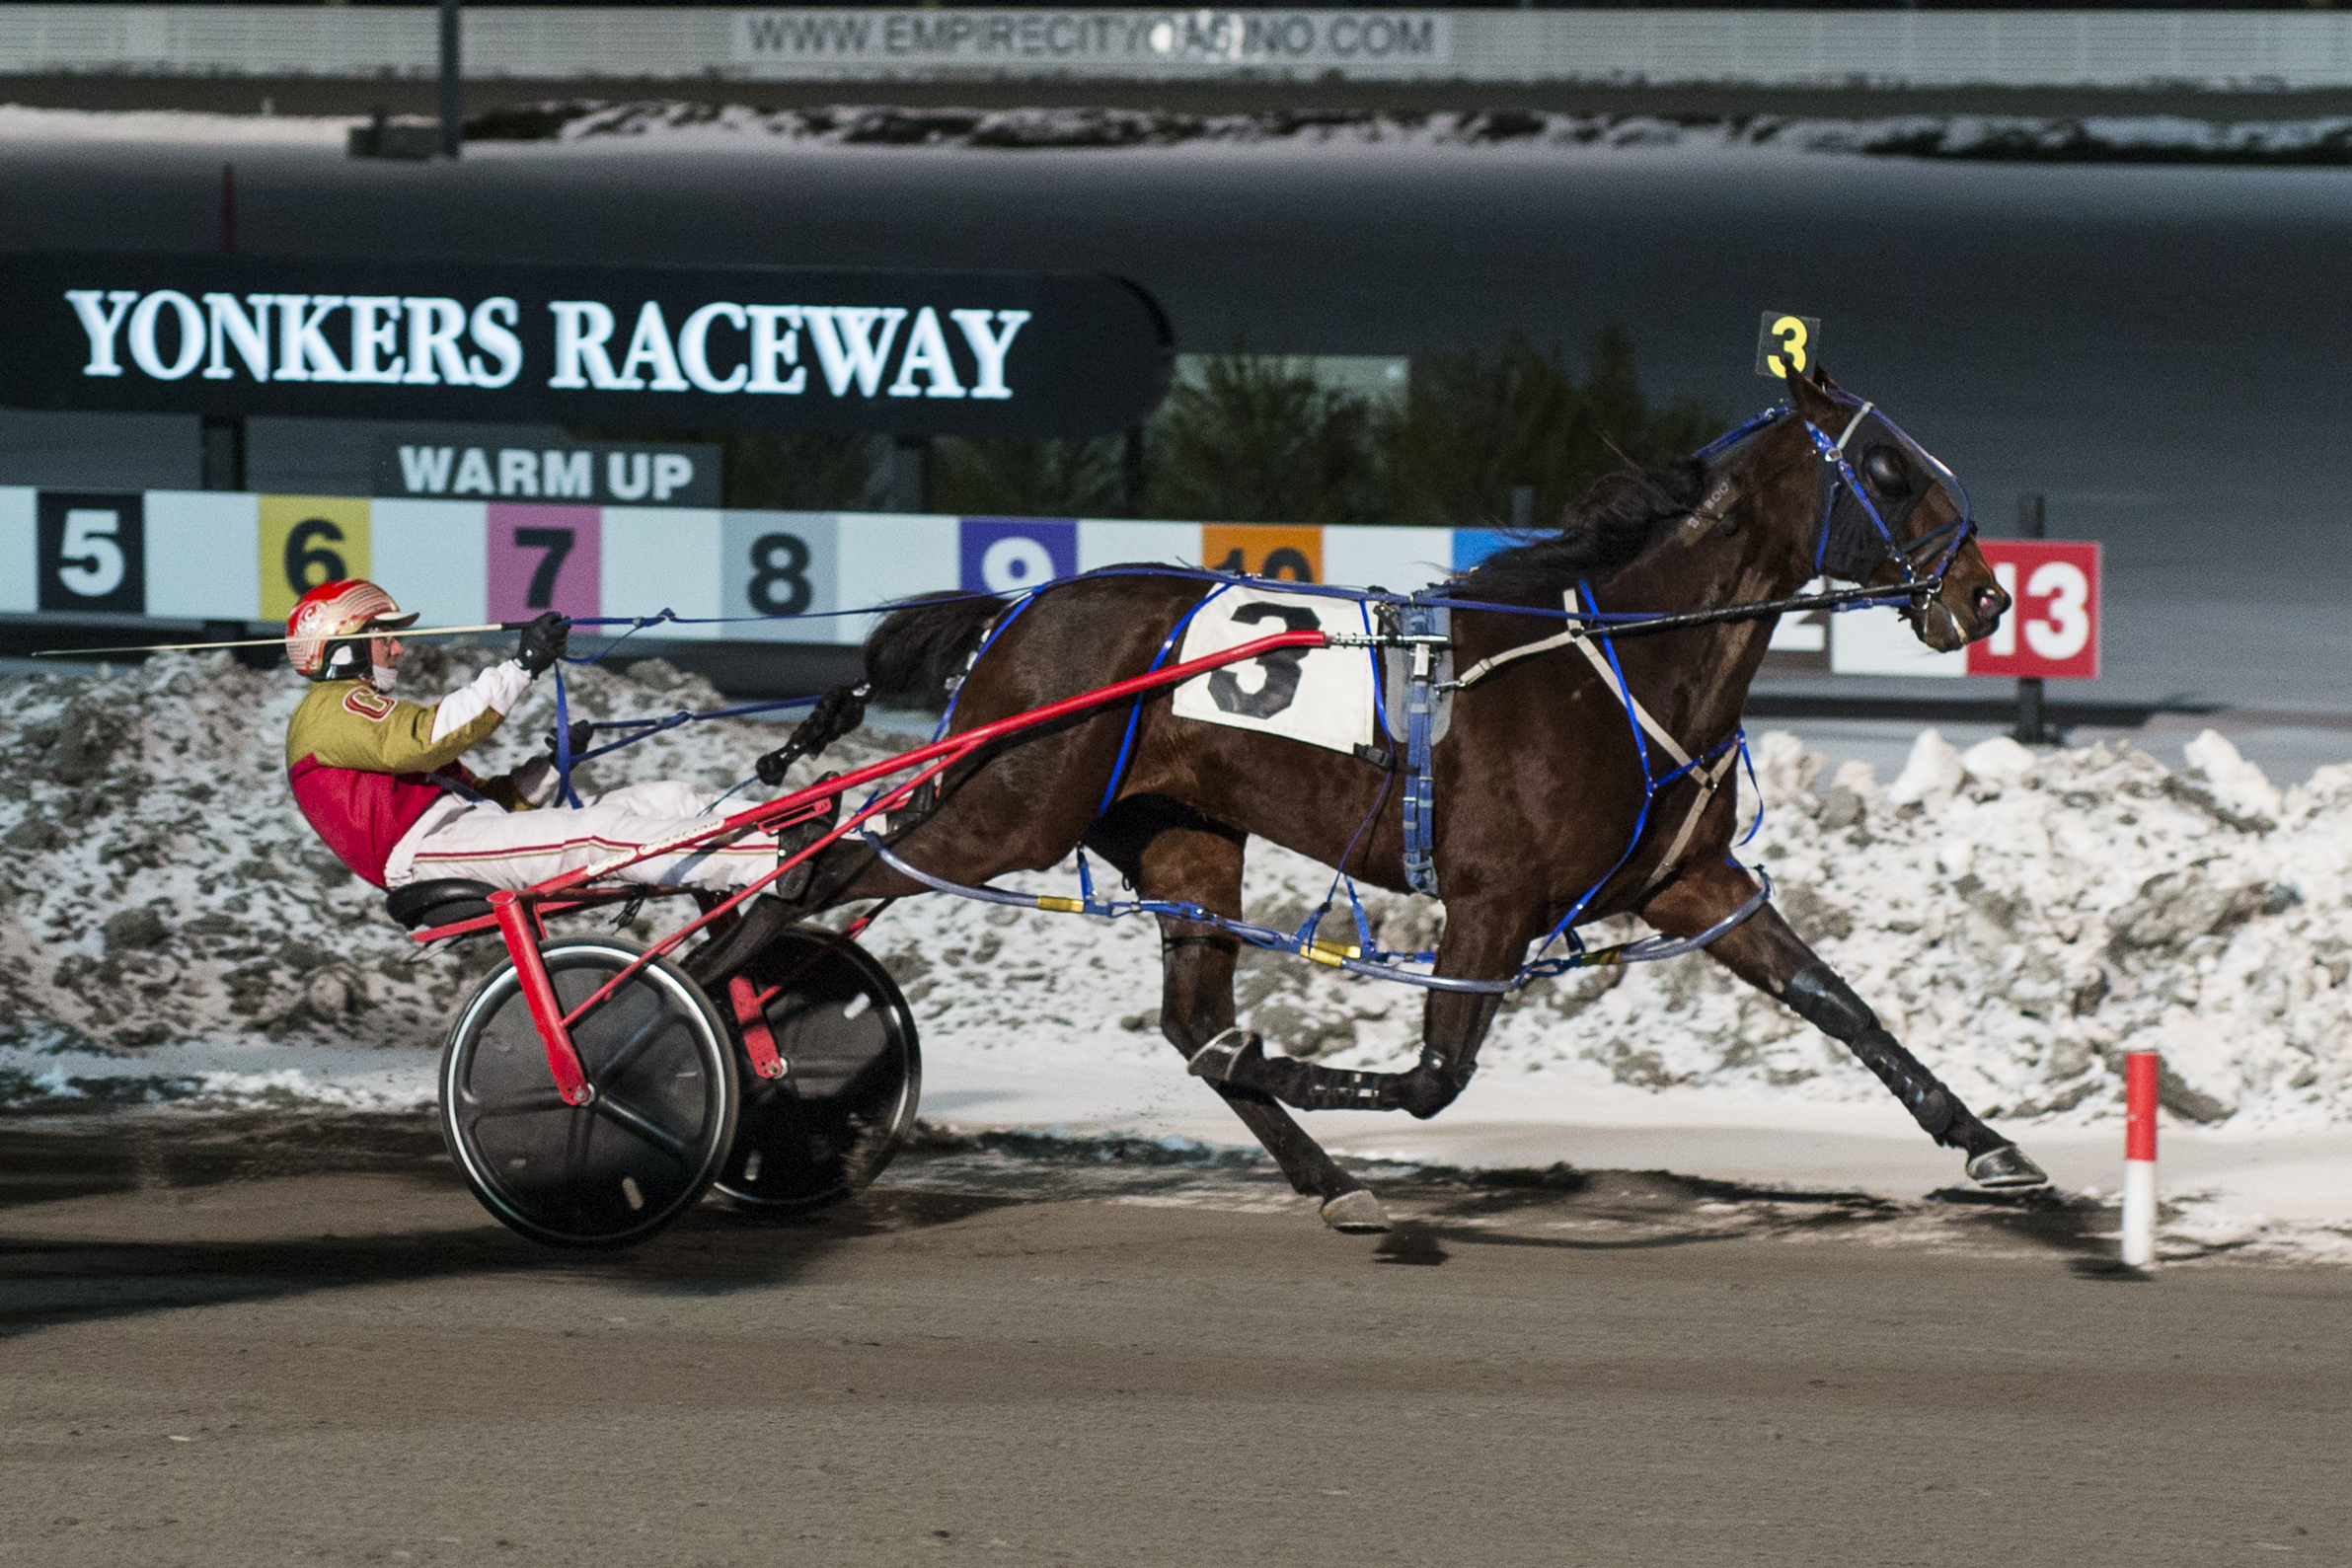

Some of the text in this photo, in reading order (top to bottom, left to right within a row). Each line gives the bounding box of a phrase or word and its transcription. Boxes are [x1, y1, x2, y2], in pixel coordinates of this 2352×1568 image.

[747, 15, 1433, 53] WWW.EMPIRECITYANO.COM
[65, 290, 1031, 399] YONKERS RACEWAY
[1768, 316, 1807, 379] 3
[399, 445, 694, 500] WARM UP
[57, 509, 125, 596] 5
[283, 518, 346, 597] 6
[513, 527, 575, 609] 7
[747, 532, 812, 618] 8
[981, 536, 1056, 600] 9
[1989, 560, 2089, 660] 13
[1208, 601, 1322, 720] 3
